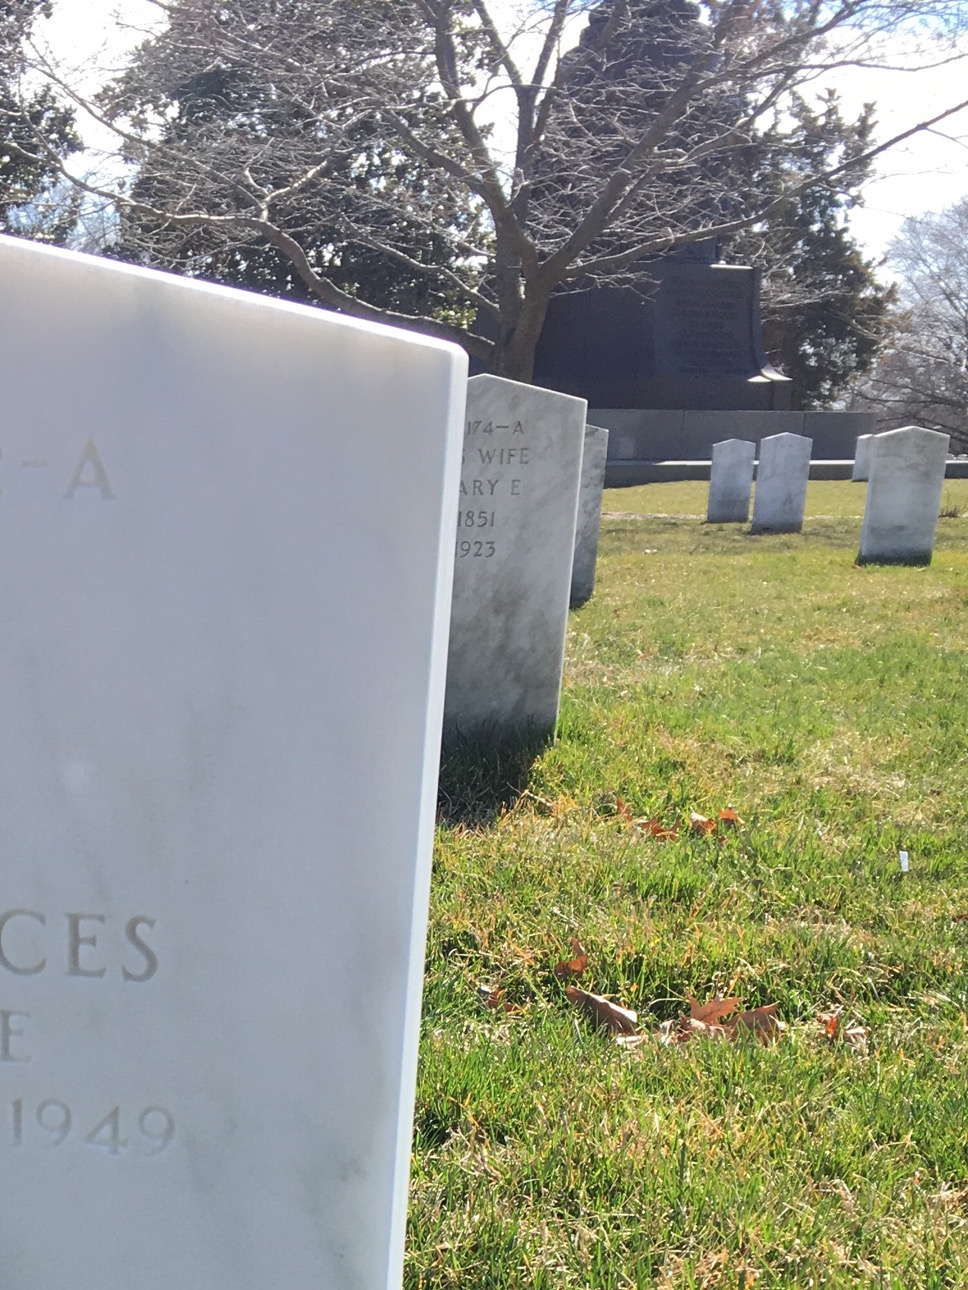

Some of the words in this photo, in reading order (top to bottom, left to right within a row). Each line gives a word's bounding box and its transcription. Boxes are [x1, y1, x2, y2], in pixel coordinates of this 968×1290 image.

[478, 448, 529, 465] WIFE
[510, 479, 521, 496] E
[457, 510, 495, 528] 1851
[454, 540, 496, 558] 1923
[8, 1099, 176, 1157] 1949
